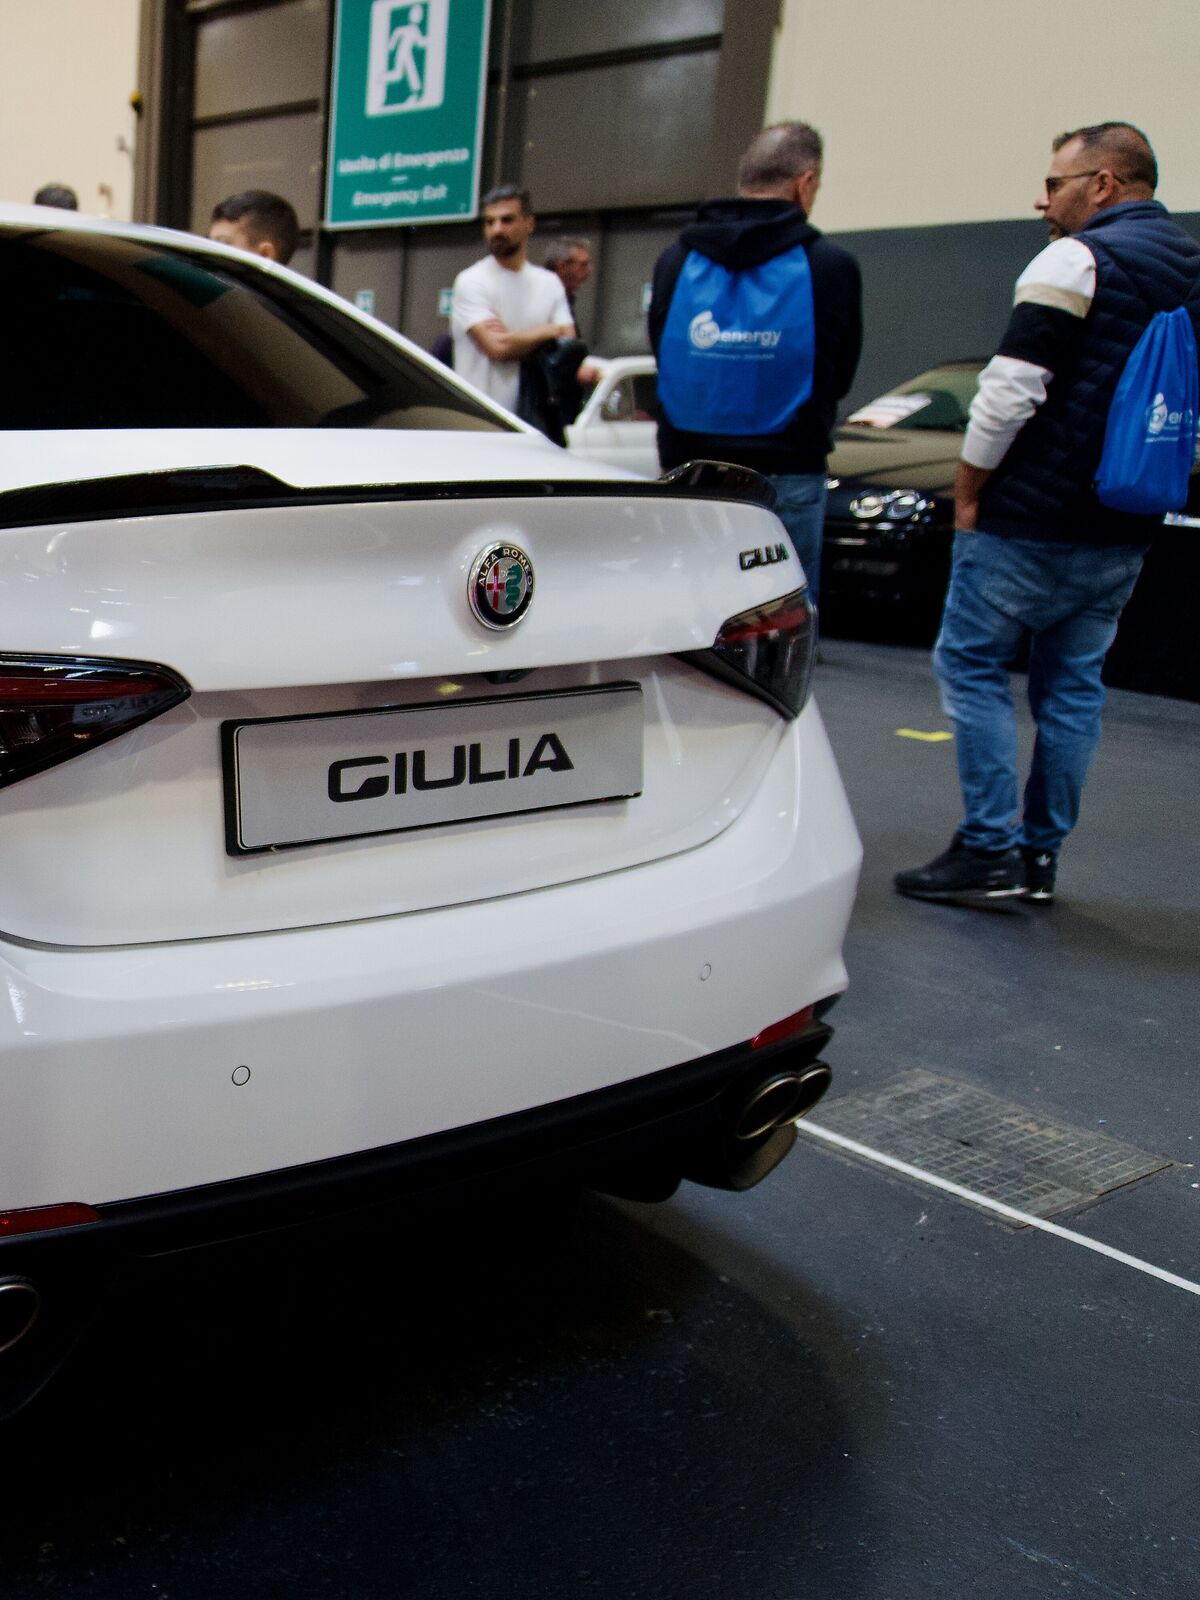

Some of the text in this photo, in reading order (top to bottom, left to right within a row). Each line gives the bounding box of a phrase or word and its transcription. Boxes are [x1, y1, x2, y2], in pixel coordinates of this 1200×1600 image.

[352, 184, 448, 207] Emergency Exit
[478, 547, 533, 588] ALFA ROMEO
[328, 732, 575, 803] GIULIA
